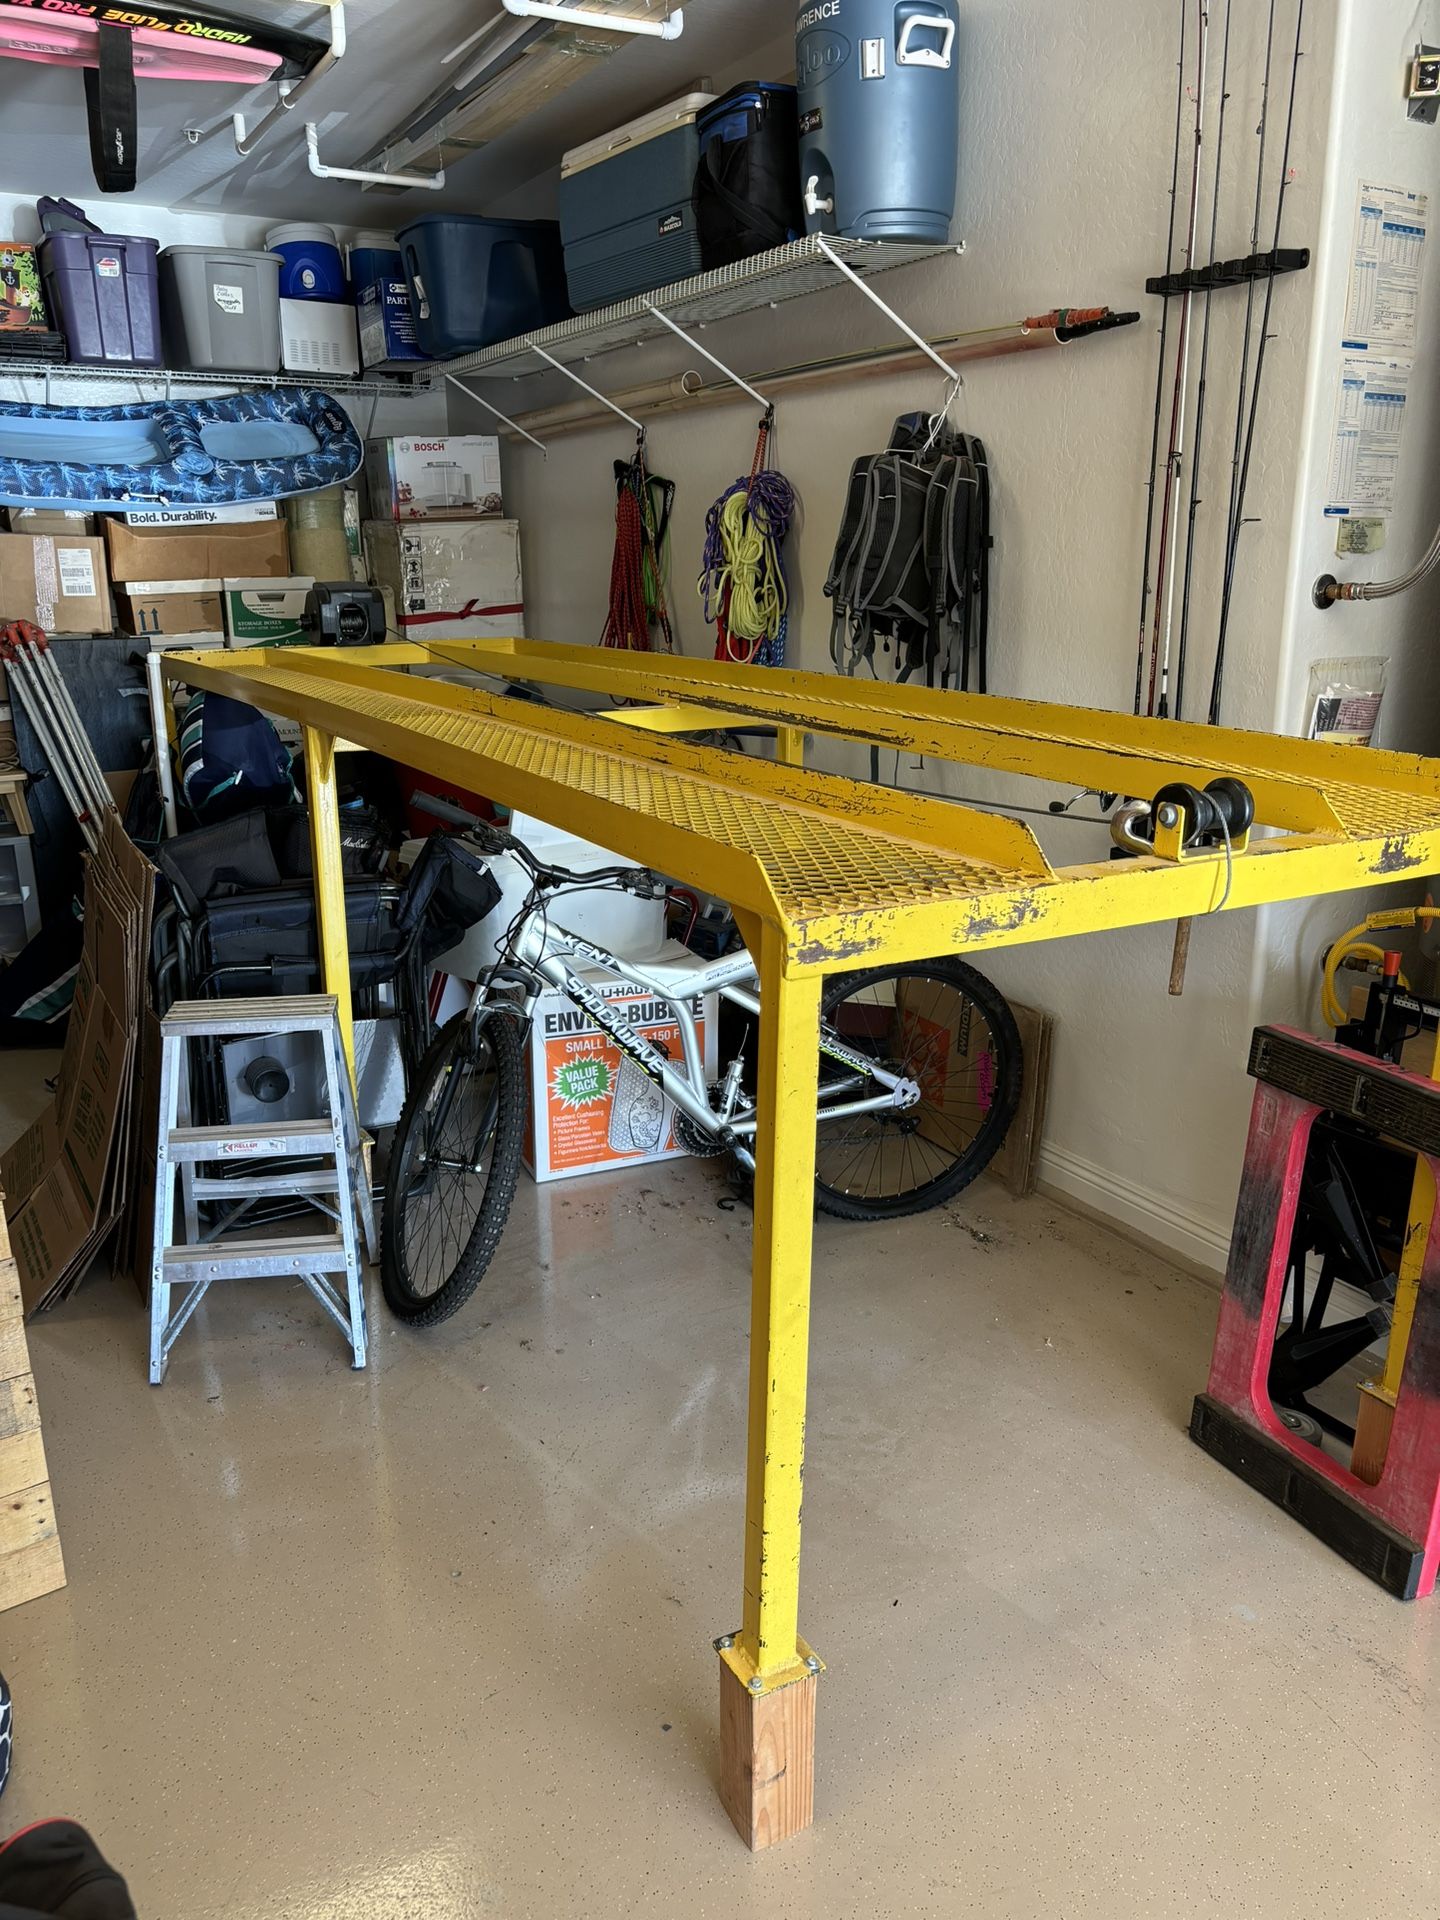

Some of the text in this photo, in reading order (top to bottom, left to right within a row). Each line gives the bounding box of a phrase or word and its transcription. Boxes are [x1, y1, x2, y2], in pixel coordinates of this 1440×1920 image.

[41, 0, 97, 16] PRO
[414, 443, 445, 452] BOSCH
[130, 510, 218, 524] Bold. Durability.
[564, 934, 619, 971] KENT
[566, 976, 664, 1074] SHOCKWAVE
[565, 1036, 603, 1053] SMALL
[818, 1038, 870, 1071] OCKWAVE
[565, 1065, 600, 1083] VALUE
[570, 1077, 599, 1094] PACK
[552, 1109, 605, 1122] Excellent Cushioning
[552, 1120, 579, 1129] Protection
